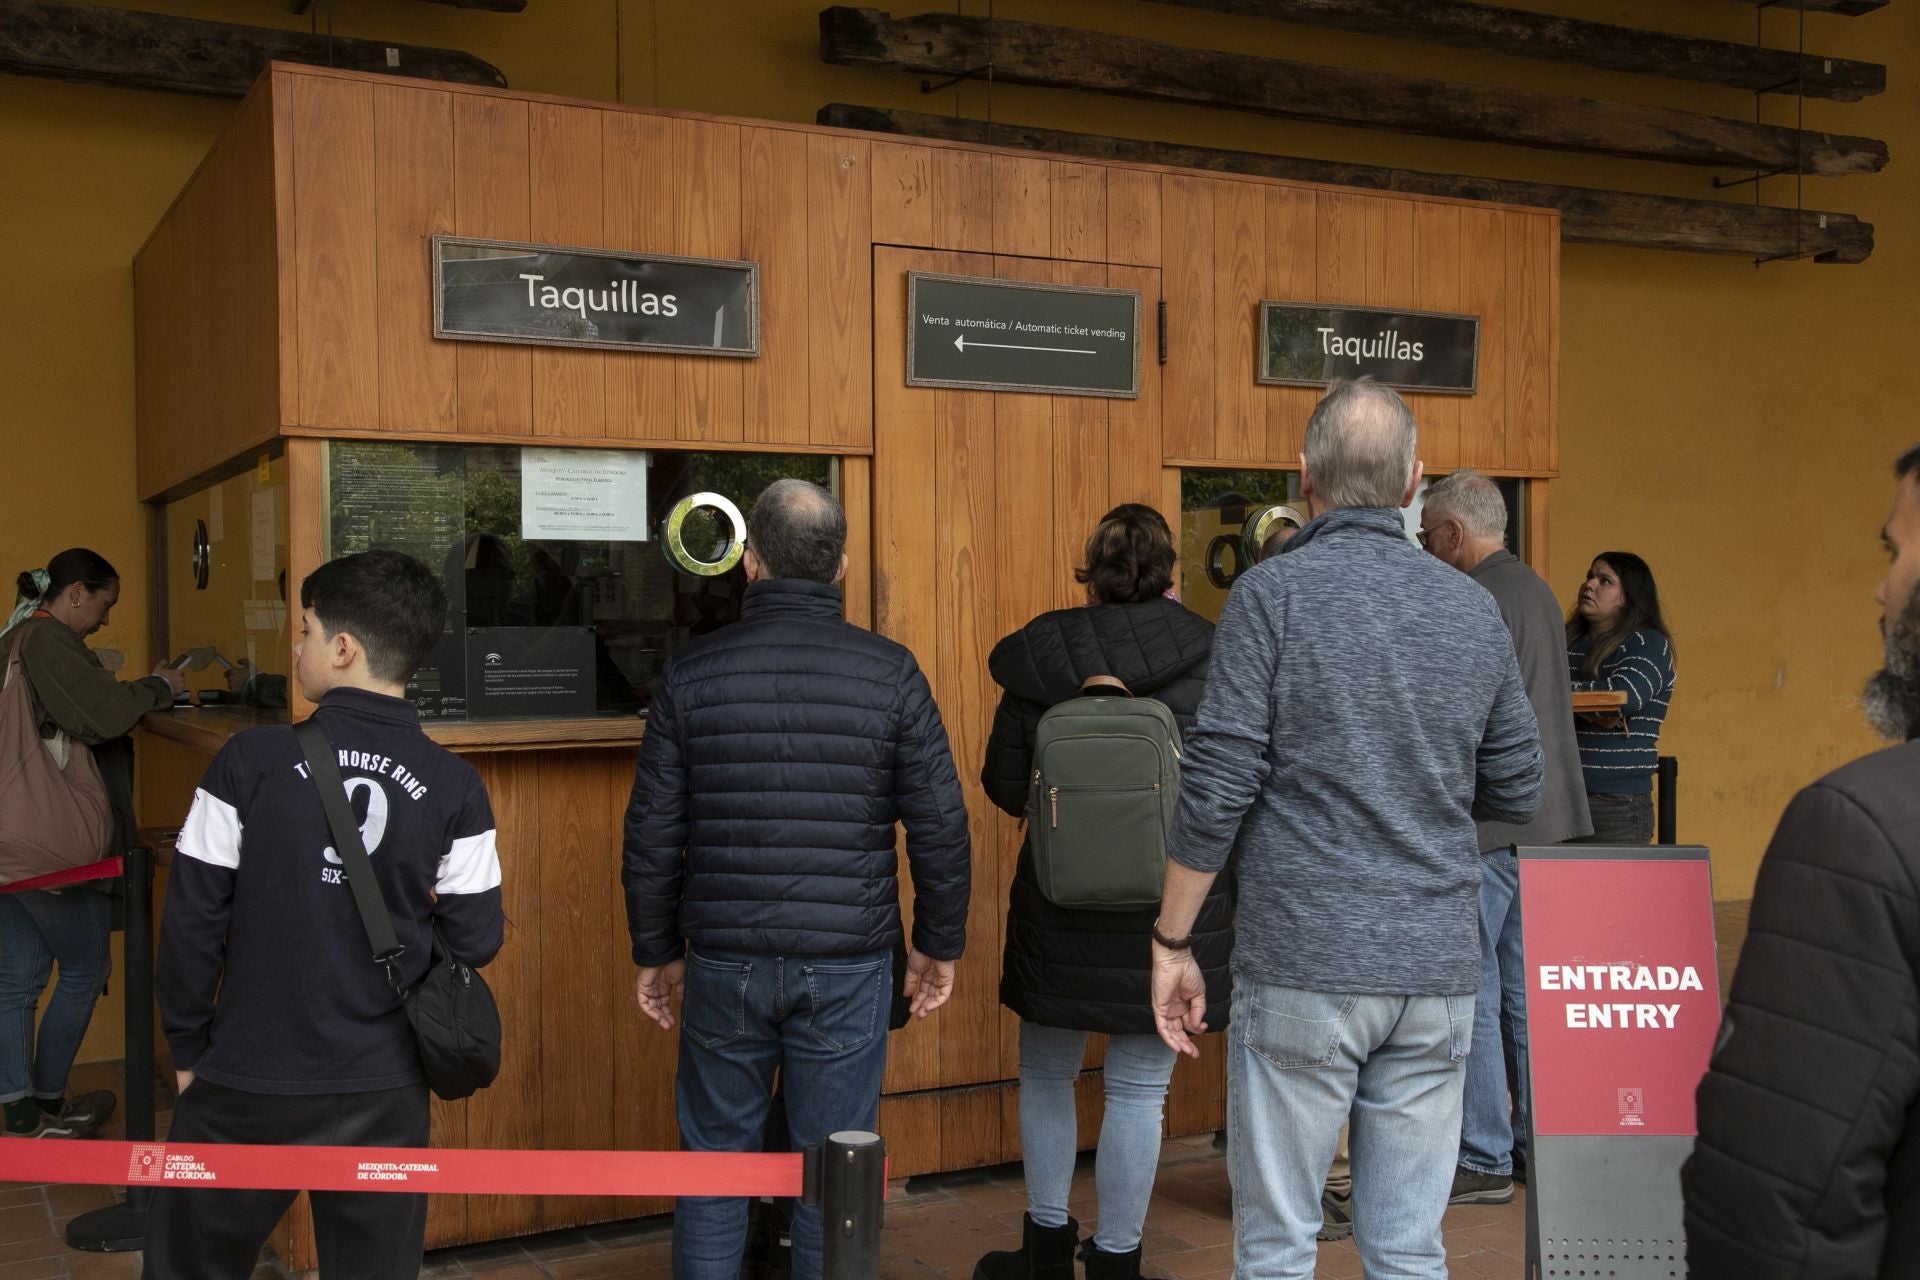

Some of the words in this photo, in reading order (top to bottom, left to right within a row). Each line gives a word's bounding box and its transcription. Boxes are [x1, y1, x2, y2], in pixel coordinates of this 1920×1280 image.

[519, 273, 678, 319] Taquillas
[922, 314, 950, 326] Venta
[955, 318, 1007, 330] automática
[1015, 321, 1062, 334] Automatic
[1064, 324, 1089, 336] ticket
[1090, 327, 1126, 341] vending
[1317, 327, 1424, 365] Taquillas
[338, 749, 392, 774] HORSE
[390, 764, 428, 801] RING
[1539, 965, 1704, 991] ENTRADA
[1565, 1003, 1681, 1029] ENTRY
[165, 1161, 206, 1171] CATEDRAL
[166, 1154, 194, 1162] CABILDO
[358, 1162, 439, 1172] MEZQUITA-CATEDRAL
[163, 1170, 175, 1179] DE
[357, 1172, 368, 1180] DE
